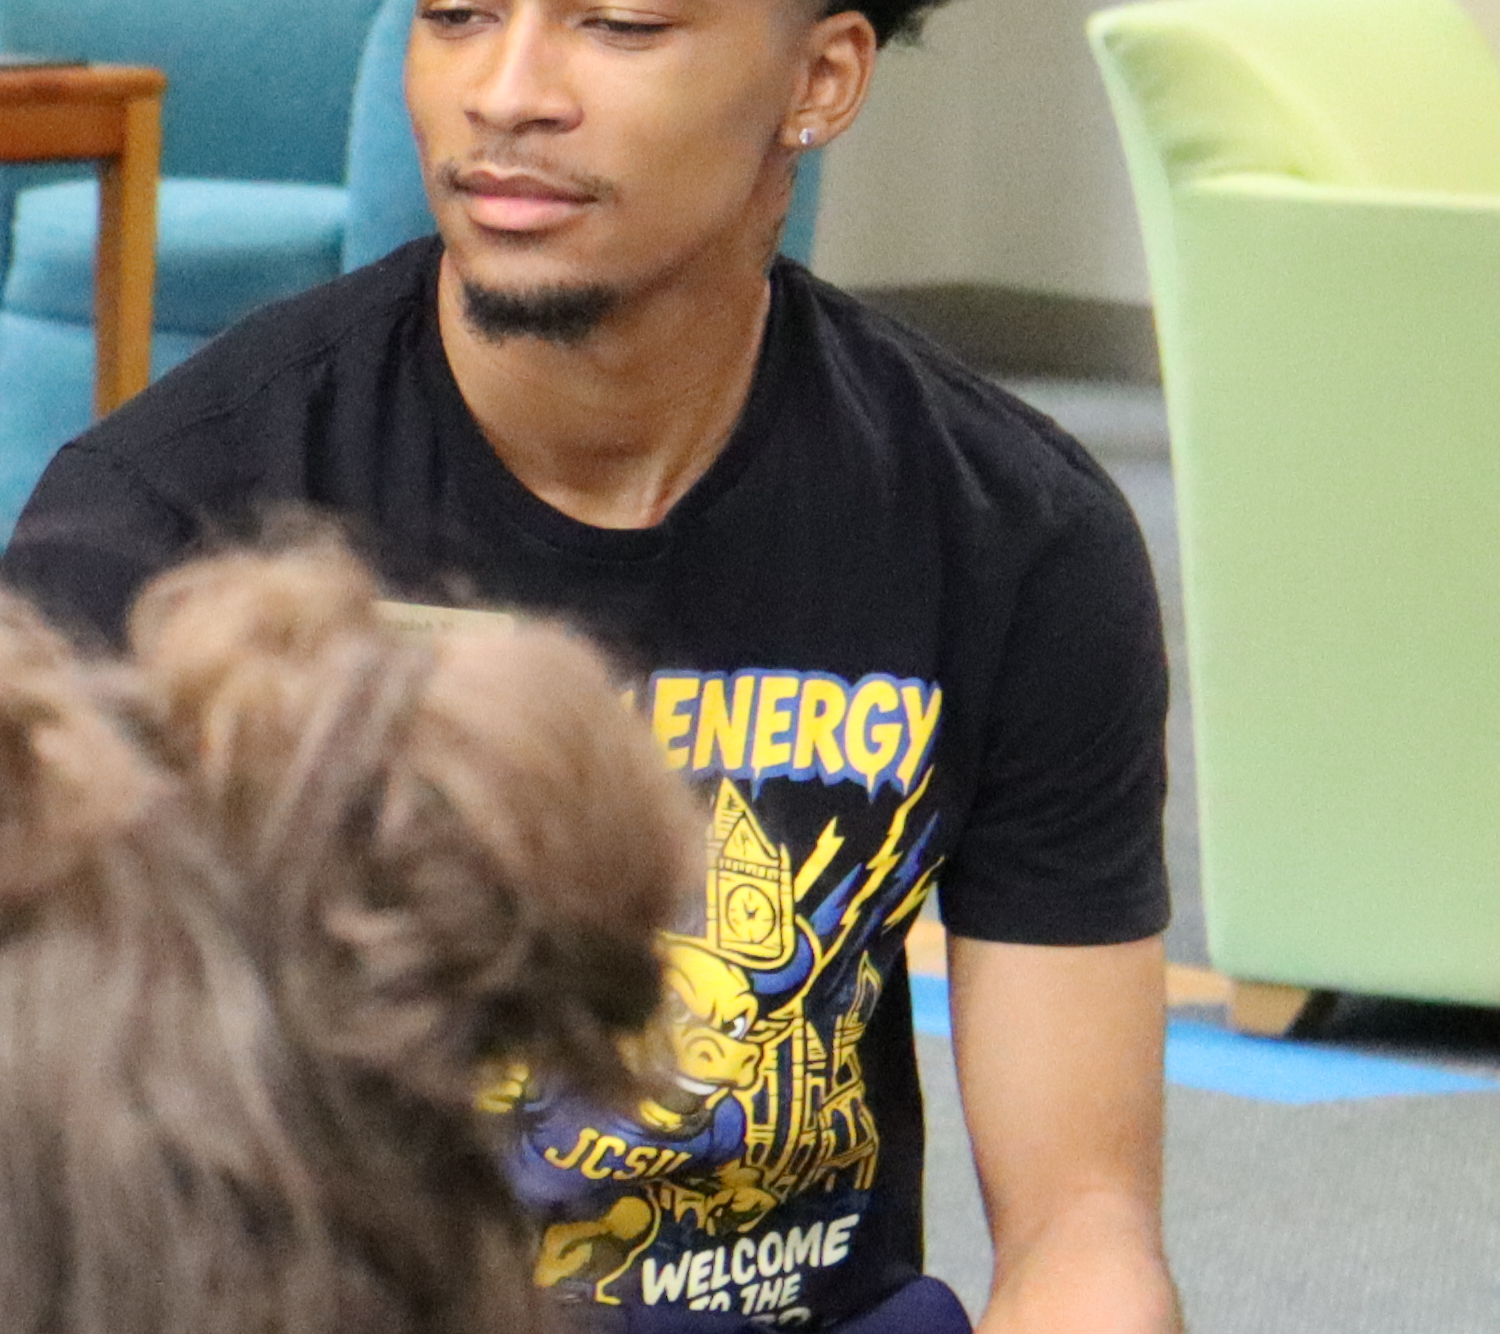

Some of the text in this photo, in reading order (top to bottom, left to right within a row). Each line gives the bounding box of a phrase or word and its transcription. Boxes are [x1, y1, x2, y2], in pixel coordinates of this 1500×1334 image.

[652, 673, 943, 793] ENERGY
[641, 1213, 861, 1307] WELCOME
[739, 1272, 803, 1316] THE
